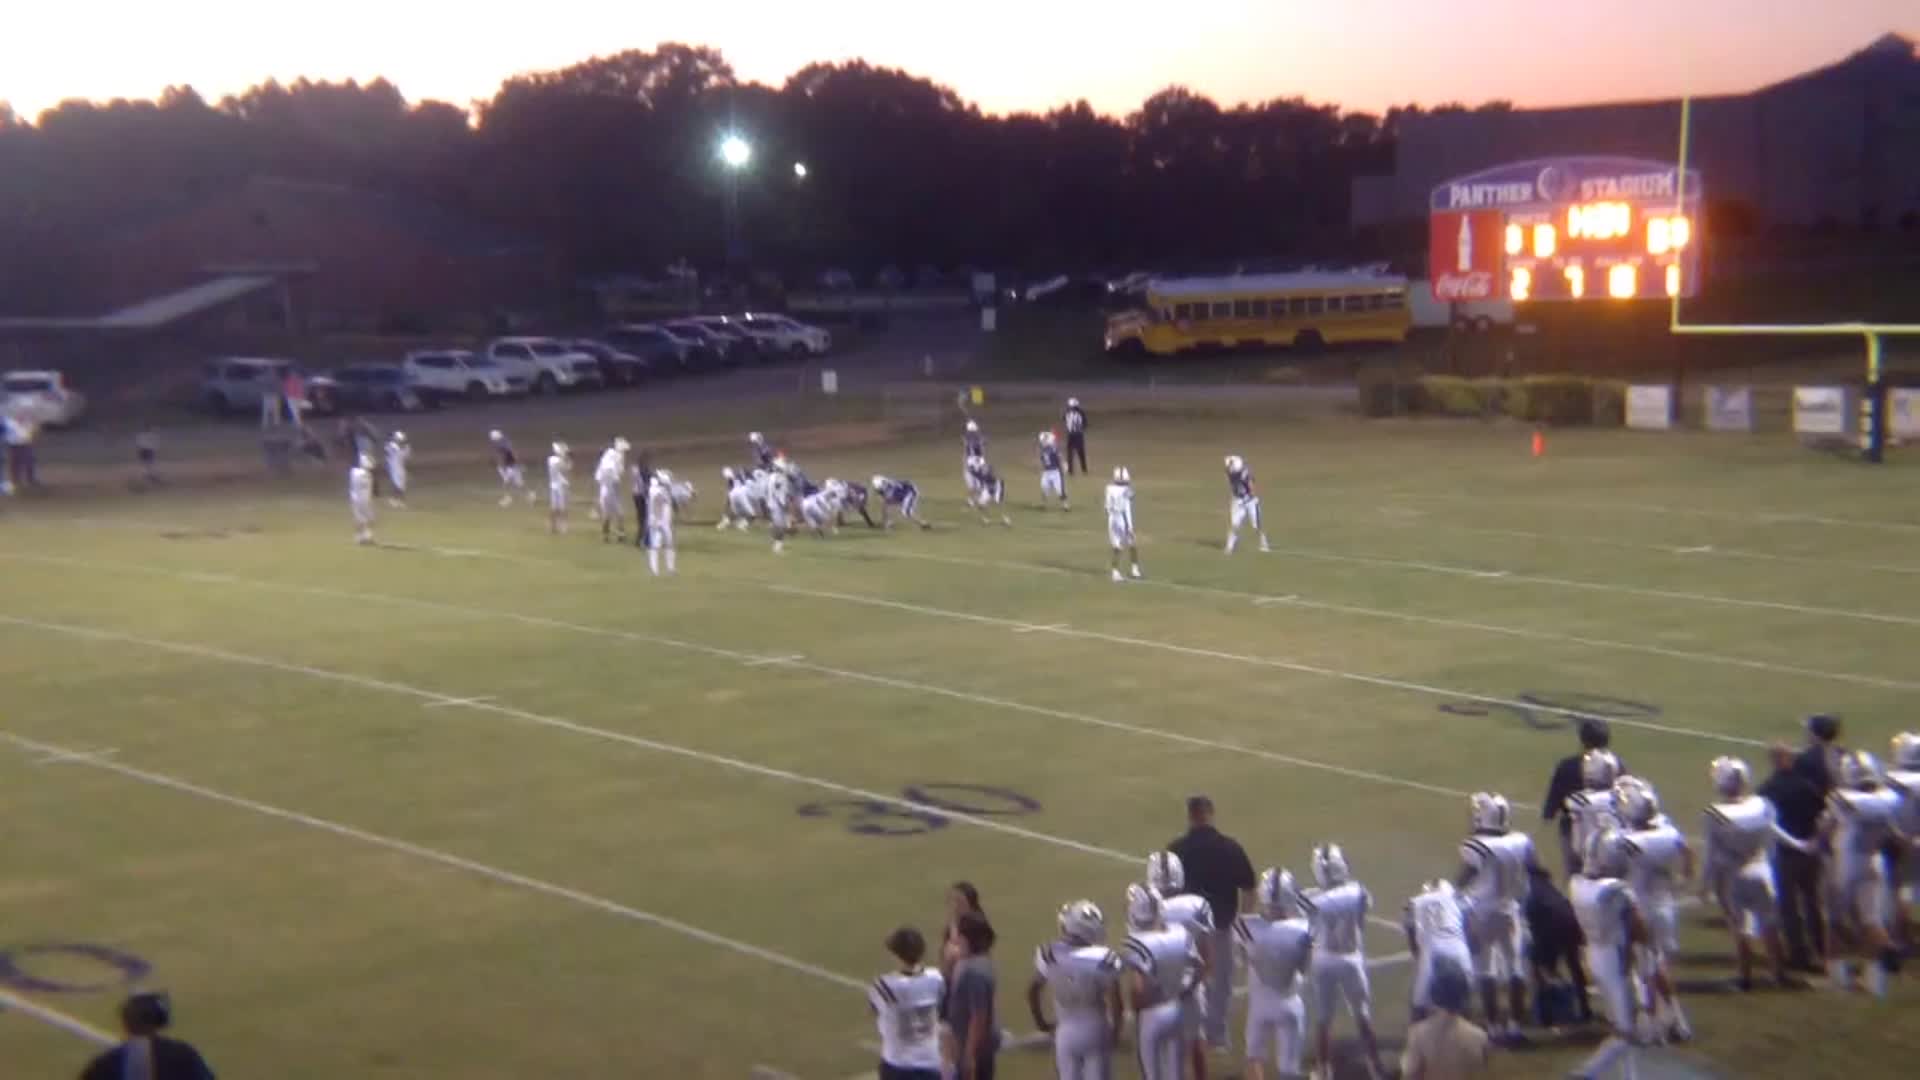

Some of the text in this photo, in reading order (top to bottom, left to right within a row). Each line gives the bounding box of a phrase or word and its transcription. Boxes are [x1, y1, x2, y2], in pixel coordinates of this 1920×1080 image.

[1450, 170, 1674, 207] PANTHER STADIUM
[795, 782, 1042, 837] 30
